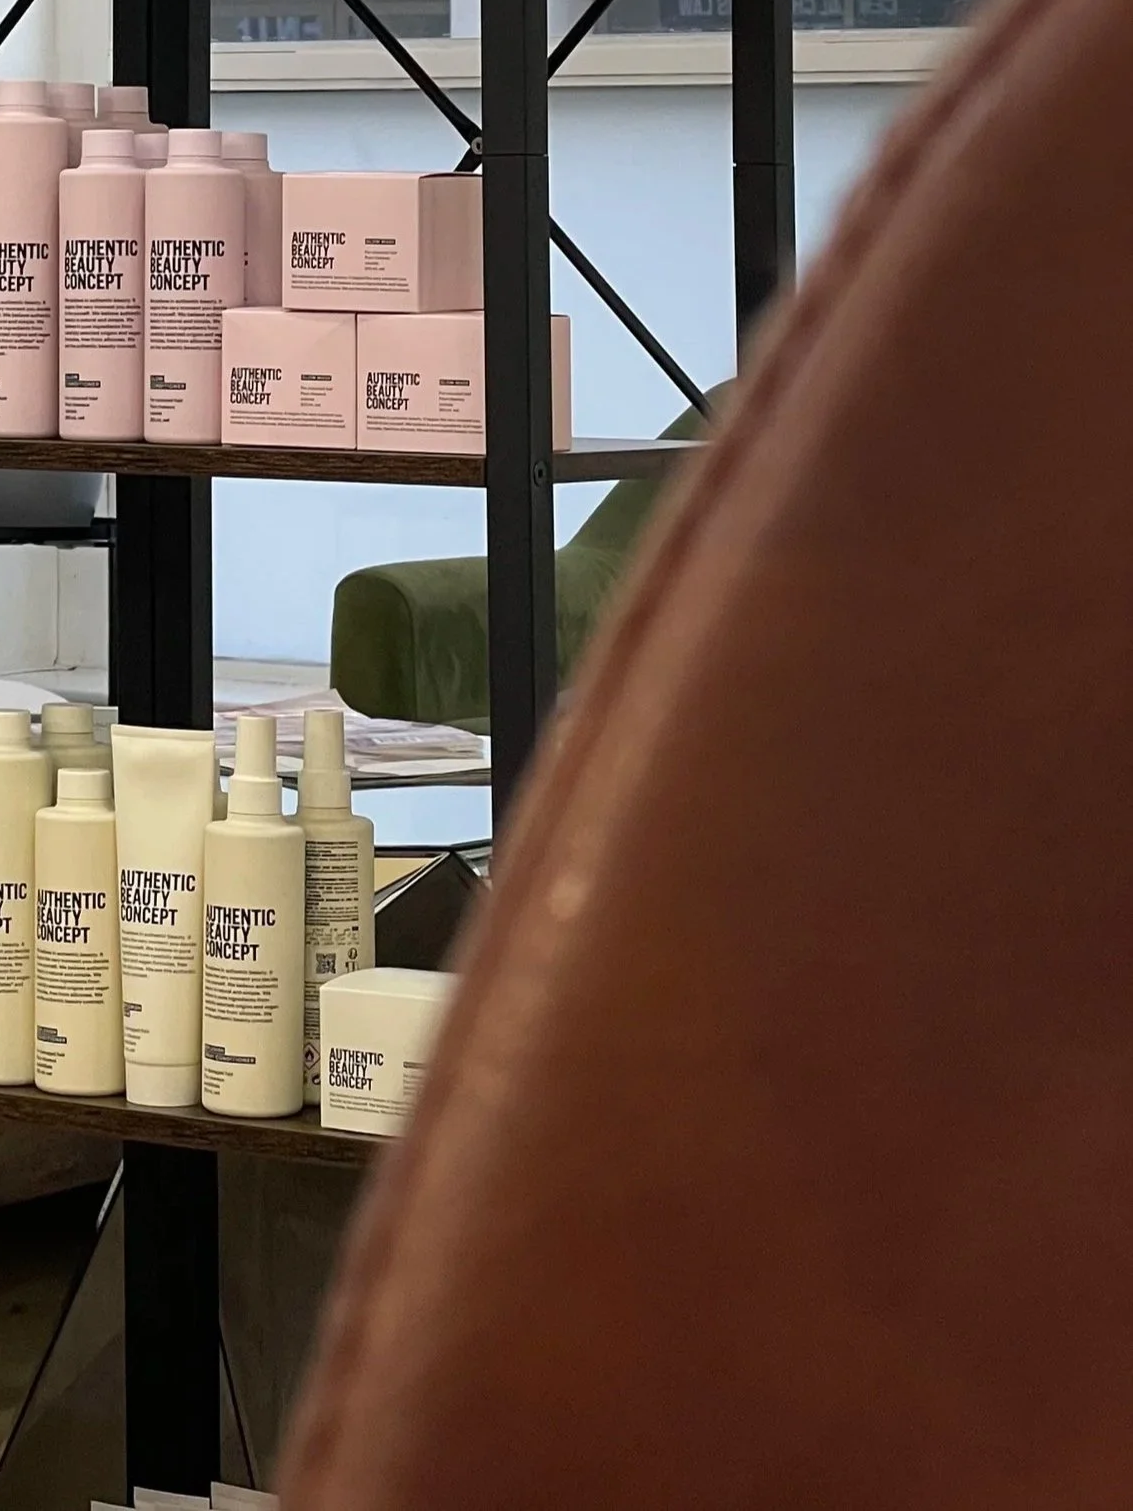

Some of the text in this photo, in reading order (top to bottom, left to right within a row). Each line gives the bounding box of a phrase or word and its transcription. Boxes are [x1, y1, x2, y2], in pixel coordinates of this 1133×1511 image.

[292, 232, 346, 246] AUTHENTIC
[66, 240, 138, 256] AUTHENTIC
[151, 240, 225, 257] AUTHENTIC
[292, 244, 329, 257] BEAUTY
[65, 257, 115, 273] BEAUTY
[151, 257, 201, 273] BEAUTY
[291, 257, 335, 270] CONCEPT
[65, 273, 123, 289] CONCEPT
[150, 274, 210, 291] CONCEPT
[231, 368, 282, 381] AUTHENTIC
[367, 372, 420, 386] AUTHENTIC
[231, 381, 266, 393] BEAUTY
[366, 386, 404, 398] BEAUTY
[230, 392, 271, 406] CONCEPT
[366, 398, 409, 411] CONCEPT
[121, 869, 196, 892] AUTHENTIC
[121, 888, 170, 907] BEAUTY
[121, 906, 178, 926] CONCEPT
[205, 943, 259, 961] CONCEPT
[330, 1048, 384, 1066] AUTHENTIC
[330, 1060, 367, 1078] BEAUTY
[329, 1074, 373, 1091] CONCEPT
